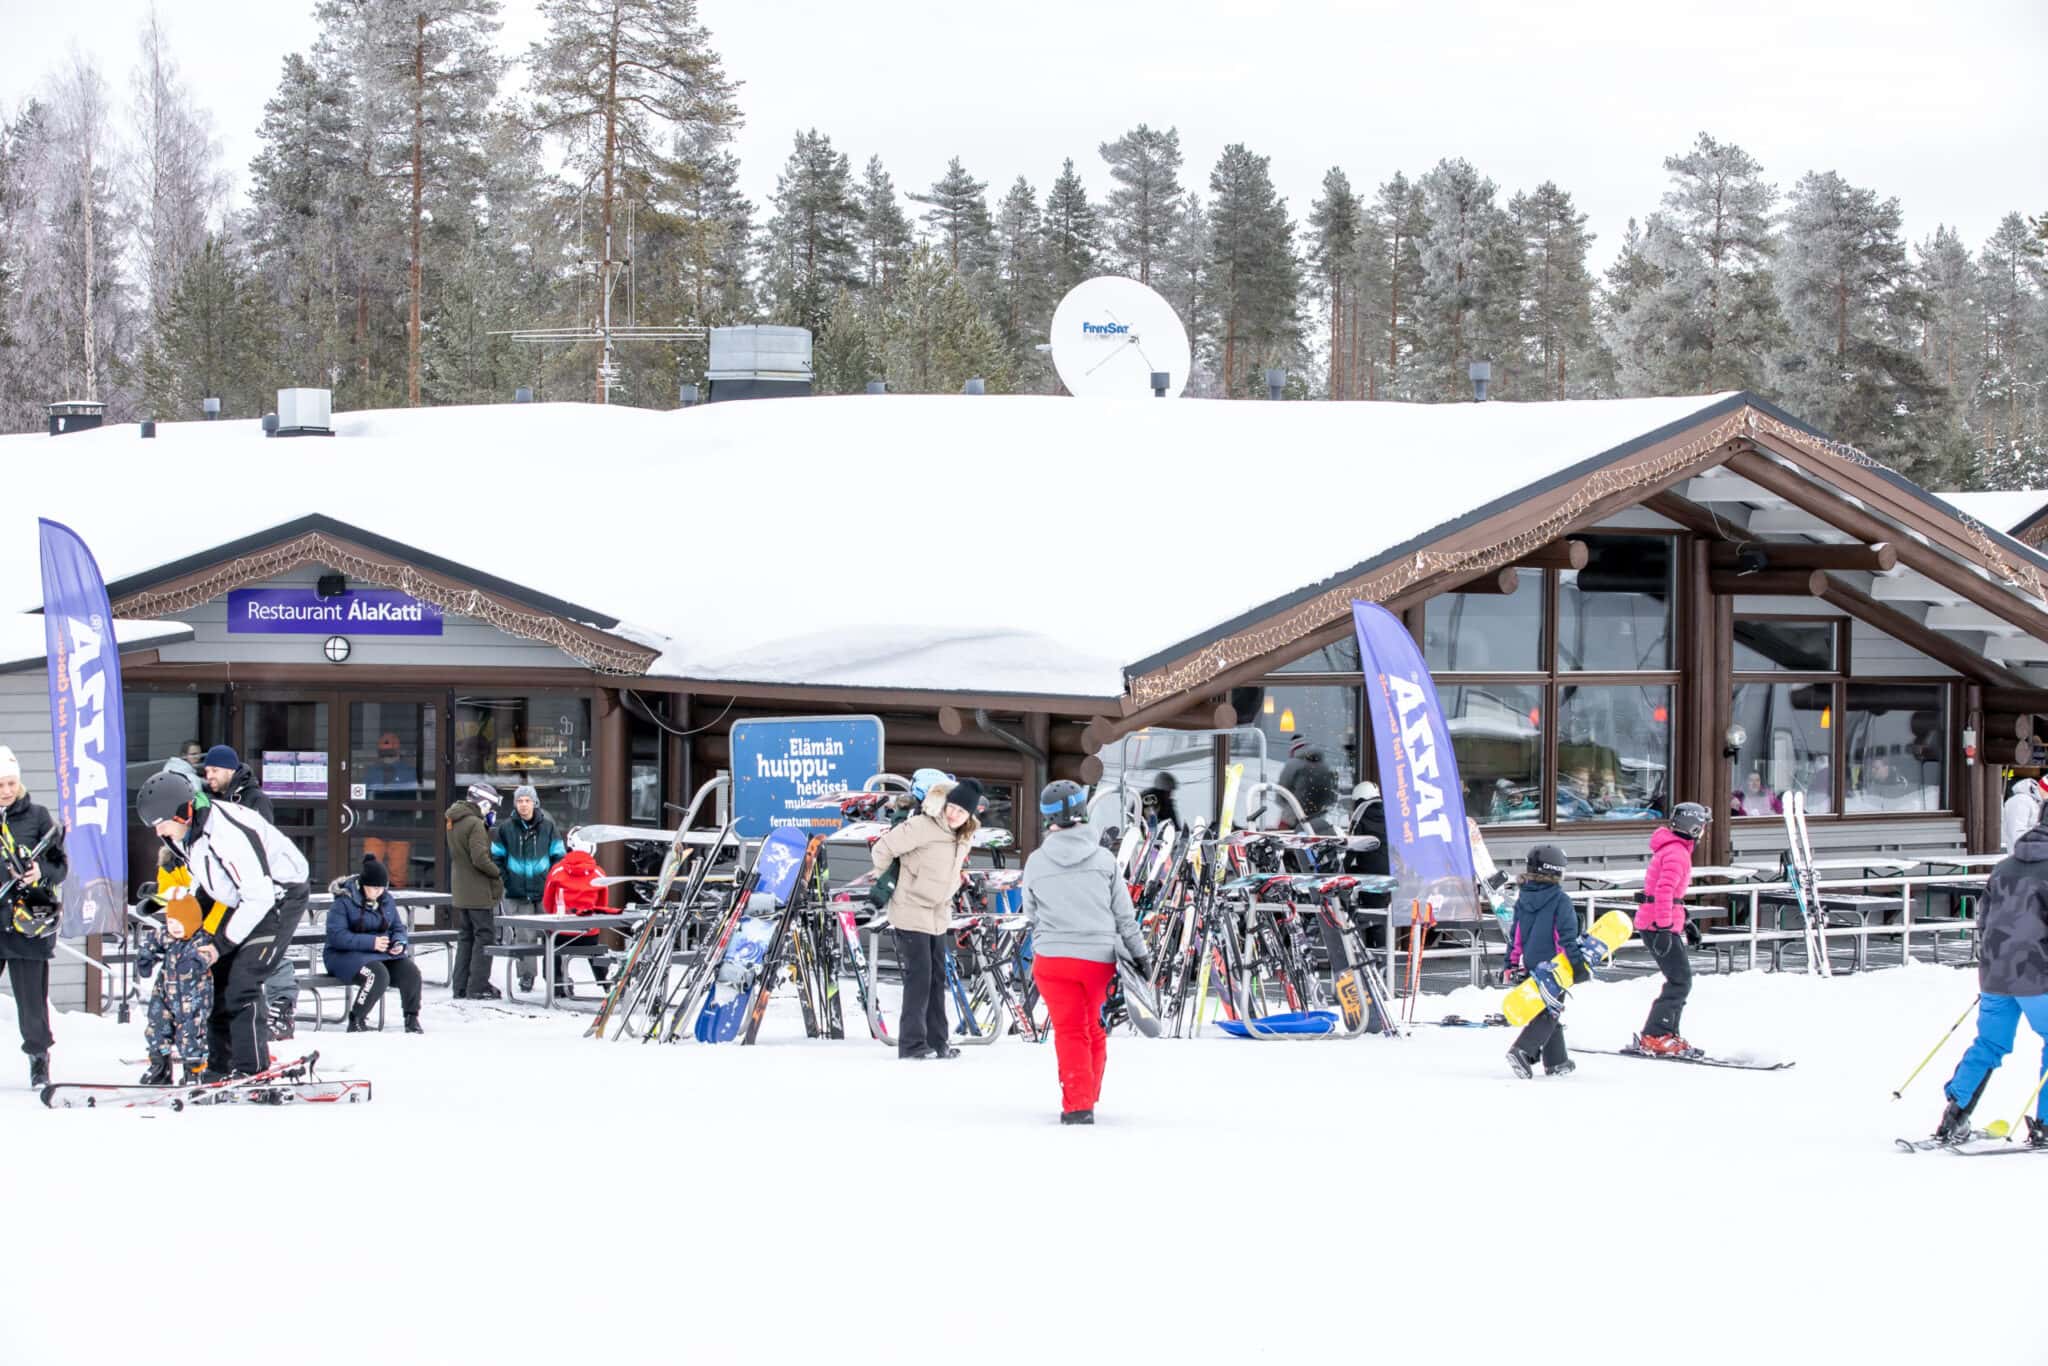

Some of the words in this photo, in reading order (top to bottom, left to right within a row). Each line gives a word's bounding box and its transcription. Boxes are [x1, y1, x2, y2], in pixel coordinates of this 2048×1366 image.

[248, 602, 342, 621] Restaurant
[347, 599, 422, 622] ÁlaKatti
[789, 737, 844, 756] Elämän
[756, 753, 836, 783] huippu-
[796, 780, 848, 796] hetkissä
[770, 816, 842, 829] ferratummoney
